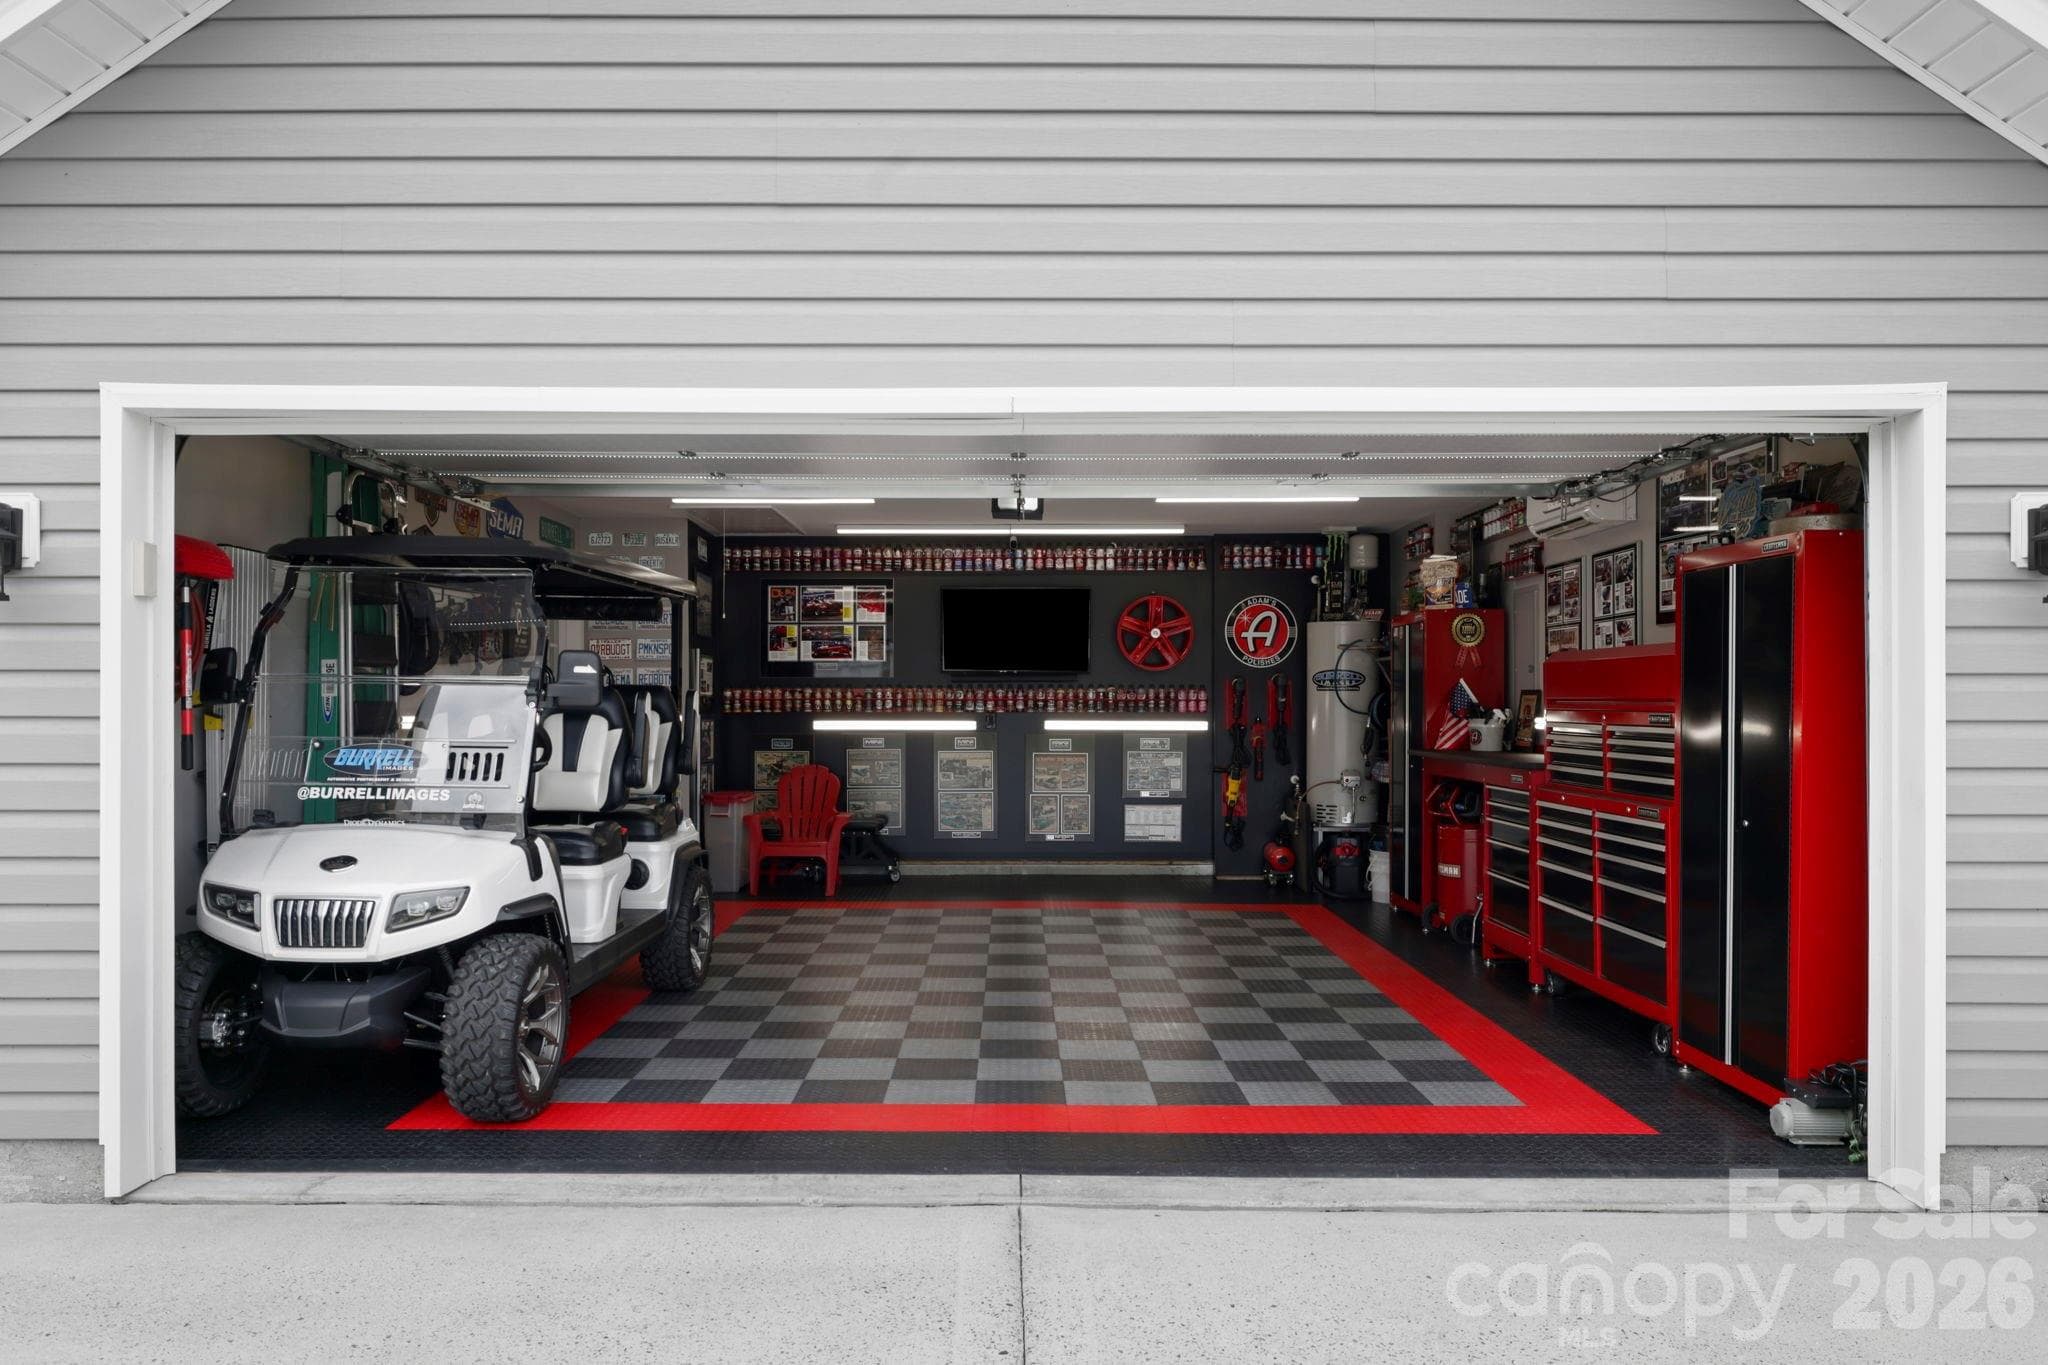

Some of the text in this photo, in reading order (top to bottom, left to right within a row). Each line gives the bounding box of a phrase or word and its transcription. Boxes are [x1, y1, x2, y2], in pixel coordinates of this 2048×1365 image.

[490, 508, 523, 538] SEMA
[1247, 597, 1277, 607] ADAM'S
[325, 662, 336, 674] 36
[1242, 655, 1281, 667] POLISHES
[333, 748, 414, 770] BURRELL
[297, 786, 450, 802] @BURRELLIMAGES
